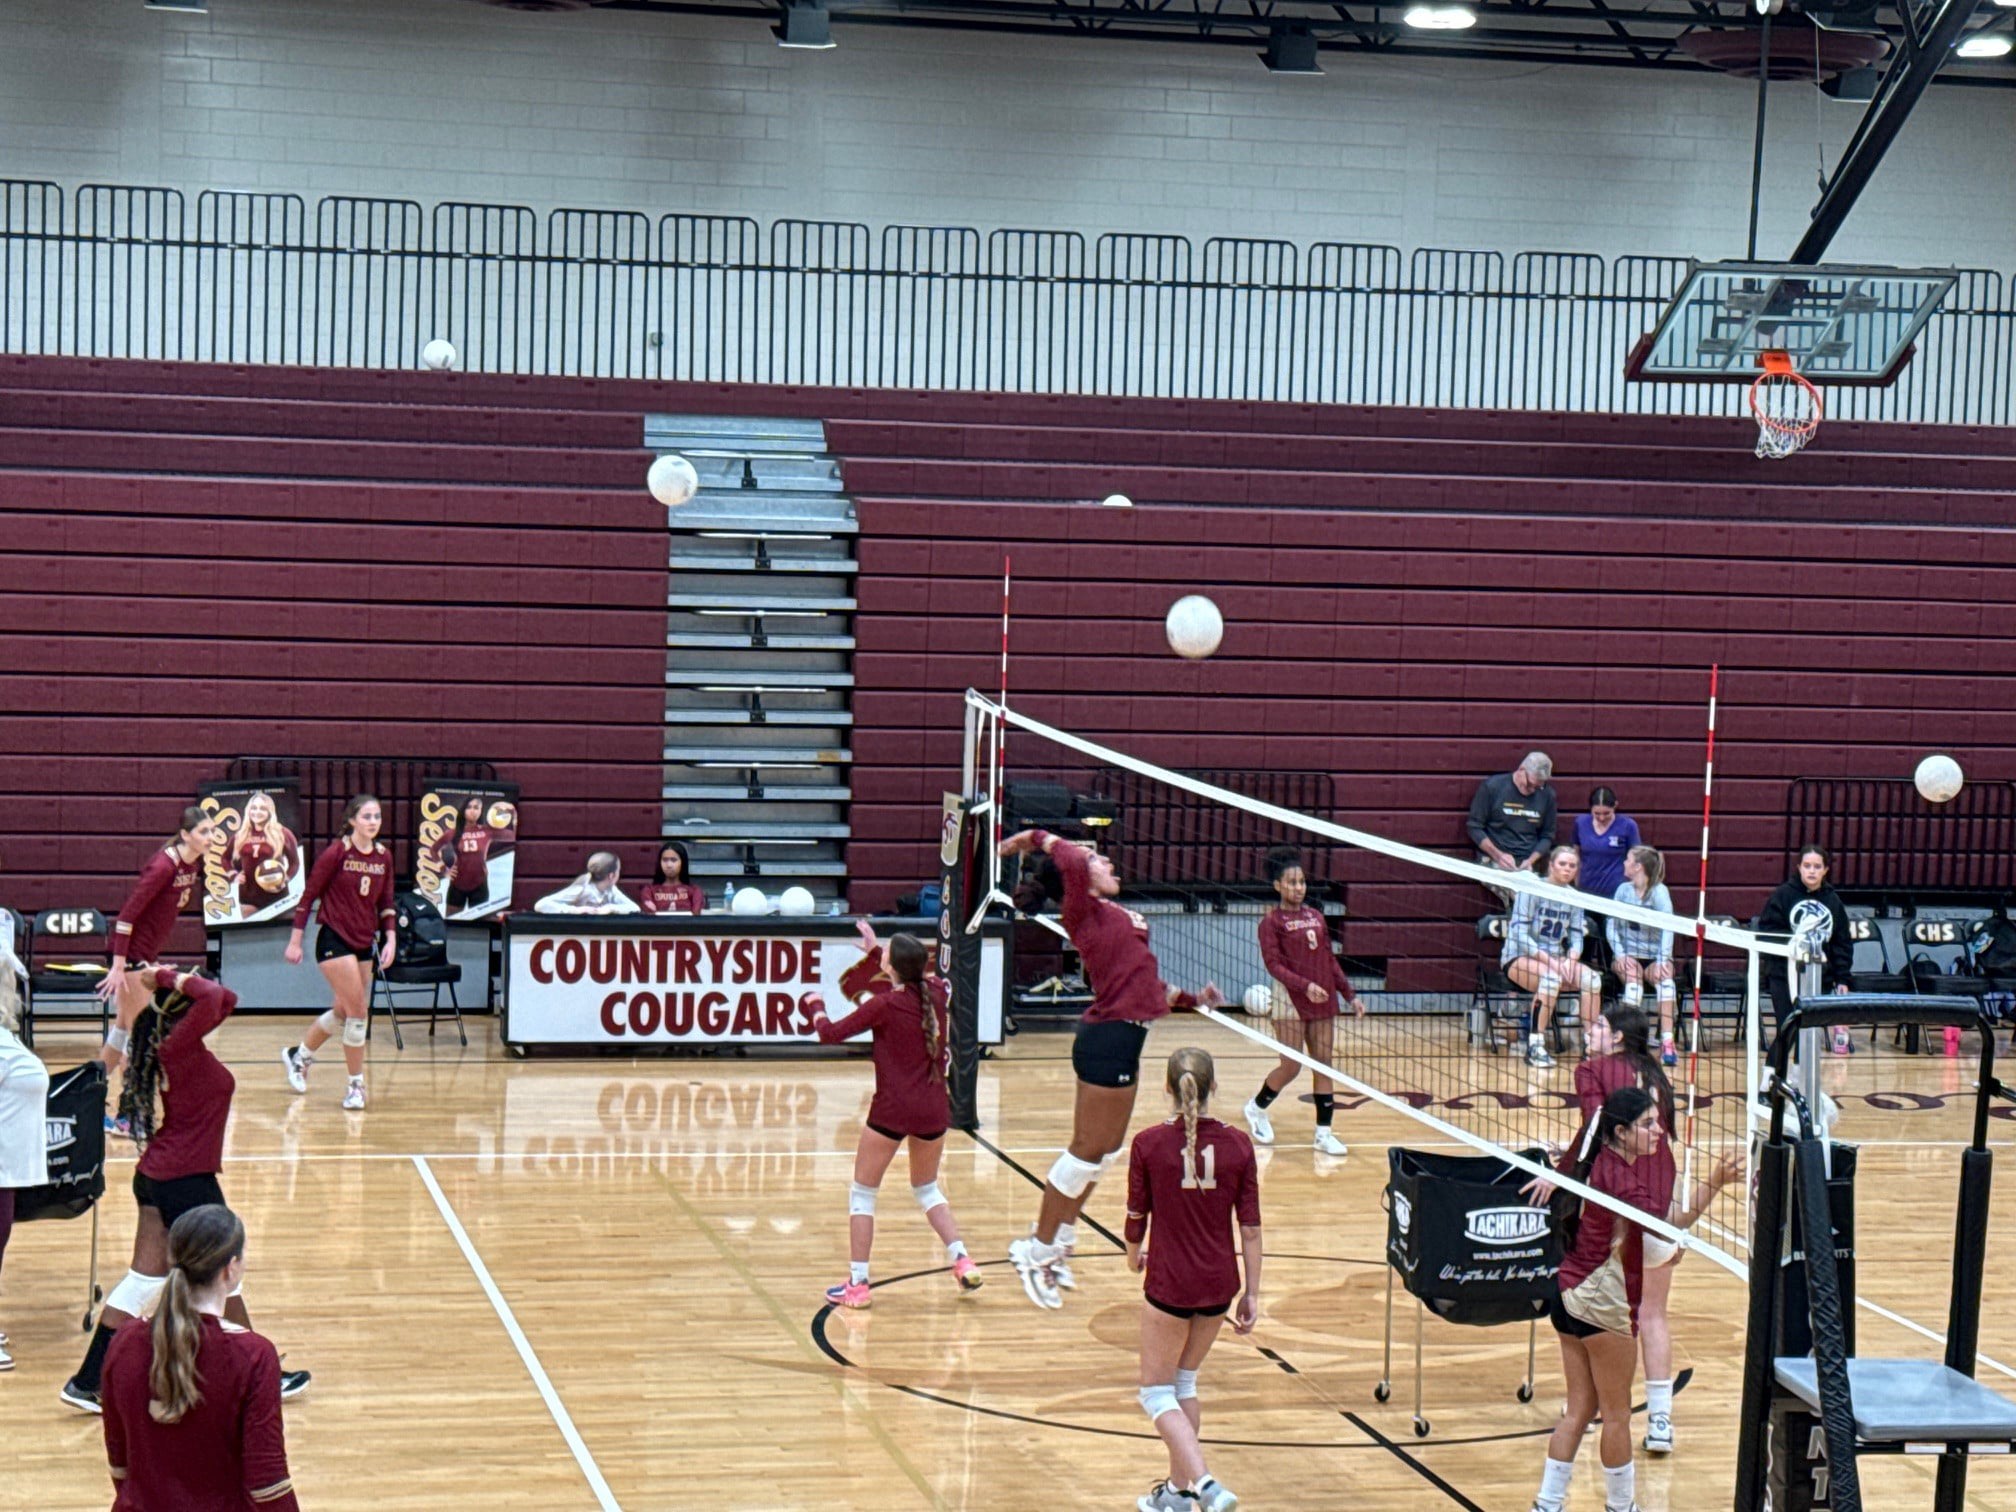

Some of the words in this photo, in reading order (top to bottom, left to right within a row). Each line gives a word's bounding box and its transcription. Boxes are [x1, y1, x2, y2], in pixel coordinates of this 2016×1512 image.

[463, 840, 478, 852] 13
[343, 860, 385, 875] COUGARS
[360, 876, 371, 897] 8
[46, 912, 94, 934] CHS
[1541, 919, 1563, 939] 20
[1915, 922, 1955, 941] CHS
[1306, 929, 1318, 950] 9
[529, 938, 822, 984] COUNTRYSIDE
[600, 991, 820, 1036] COUGARS
[1180, 1144, 1217, 1190] 11
[1465, 1208, 1550, 1240] TACHIKARA
